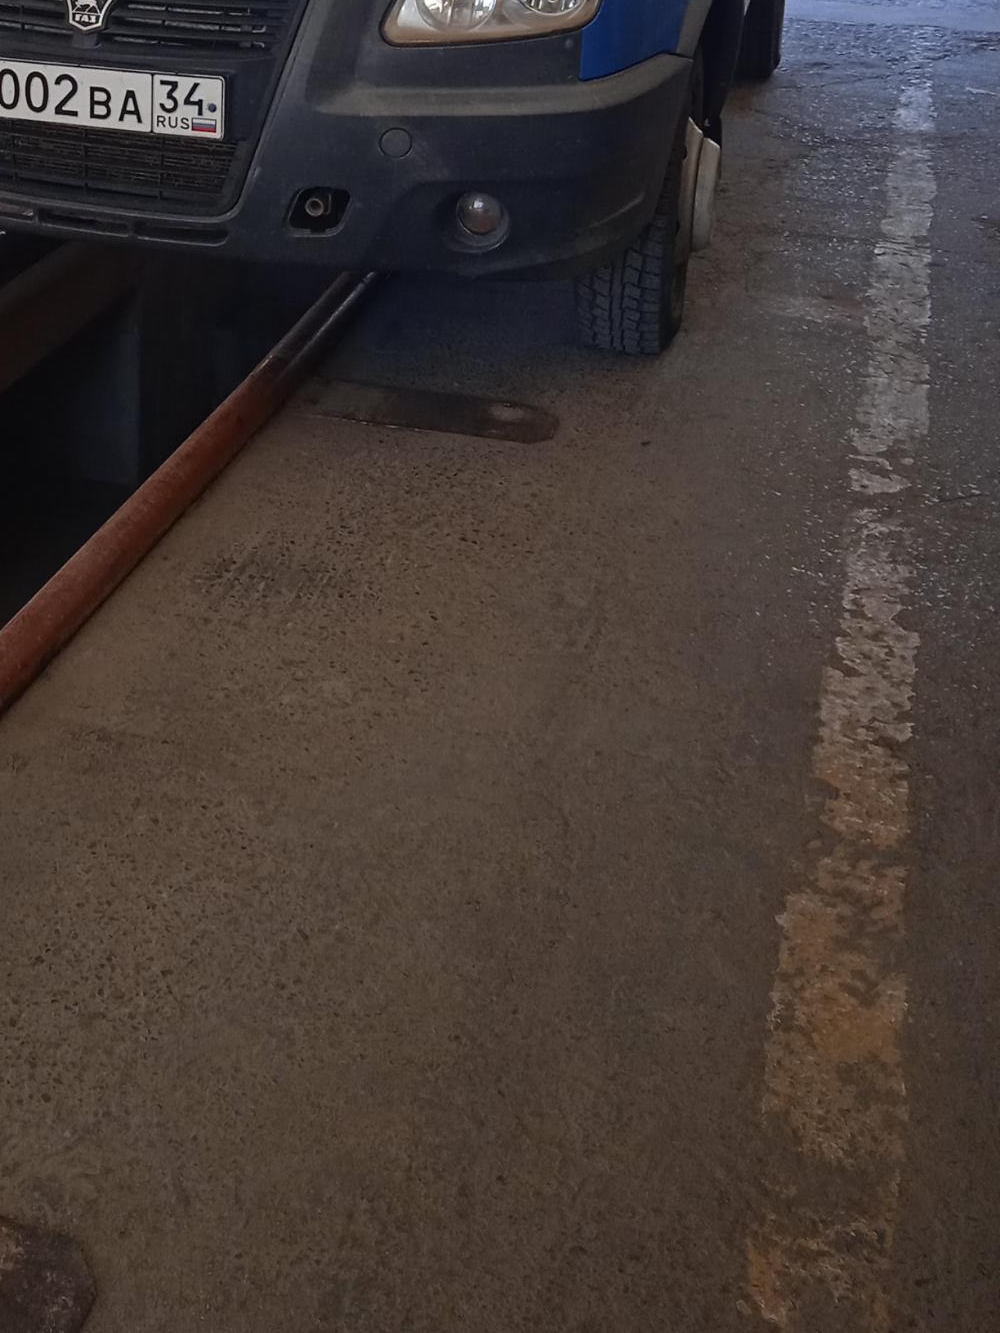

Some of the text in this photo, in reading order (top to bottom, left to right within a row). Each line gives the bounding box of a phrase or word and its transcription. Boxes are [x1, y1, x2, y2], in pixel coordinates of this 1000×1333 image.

[74, 12, 98, 24] ГАЗ
[158, 79, 204, 116] 34
[156, 115, 191, 131] RUS
